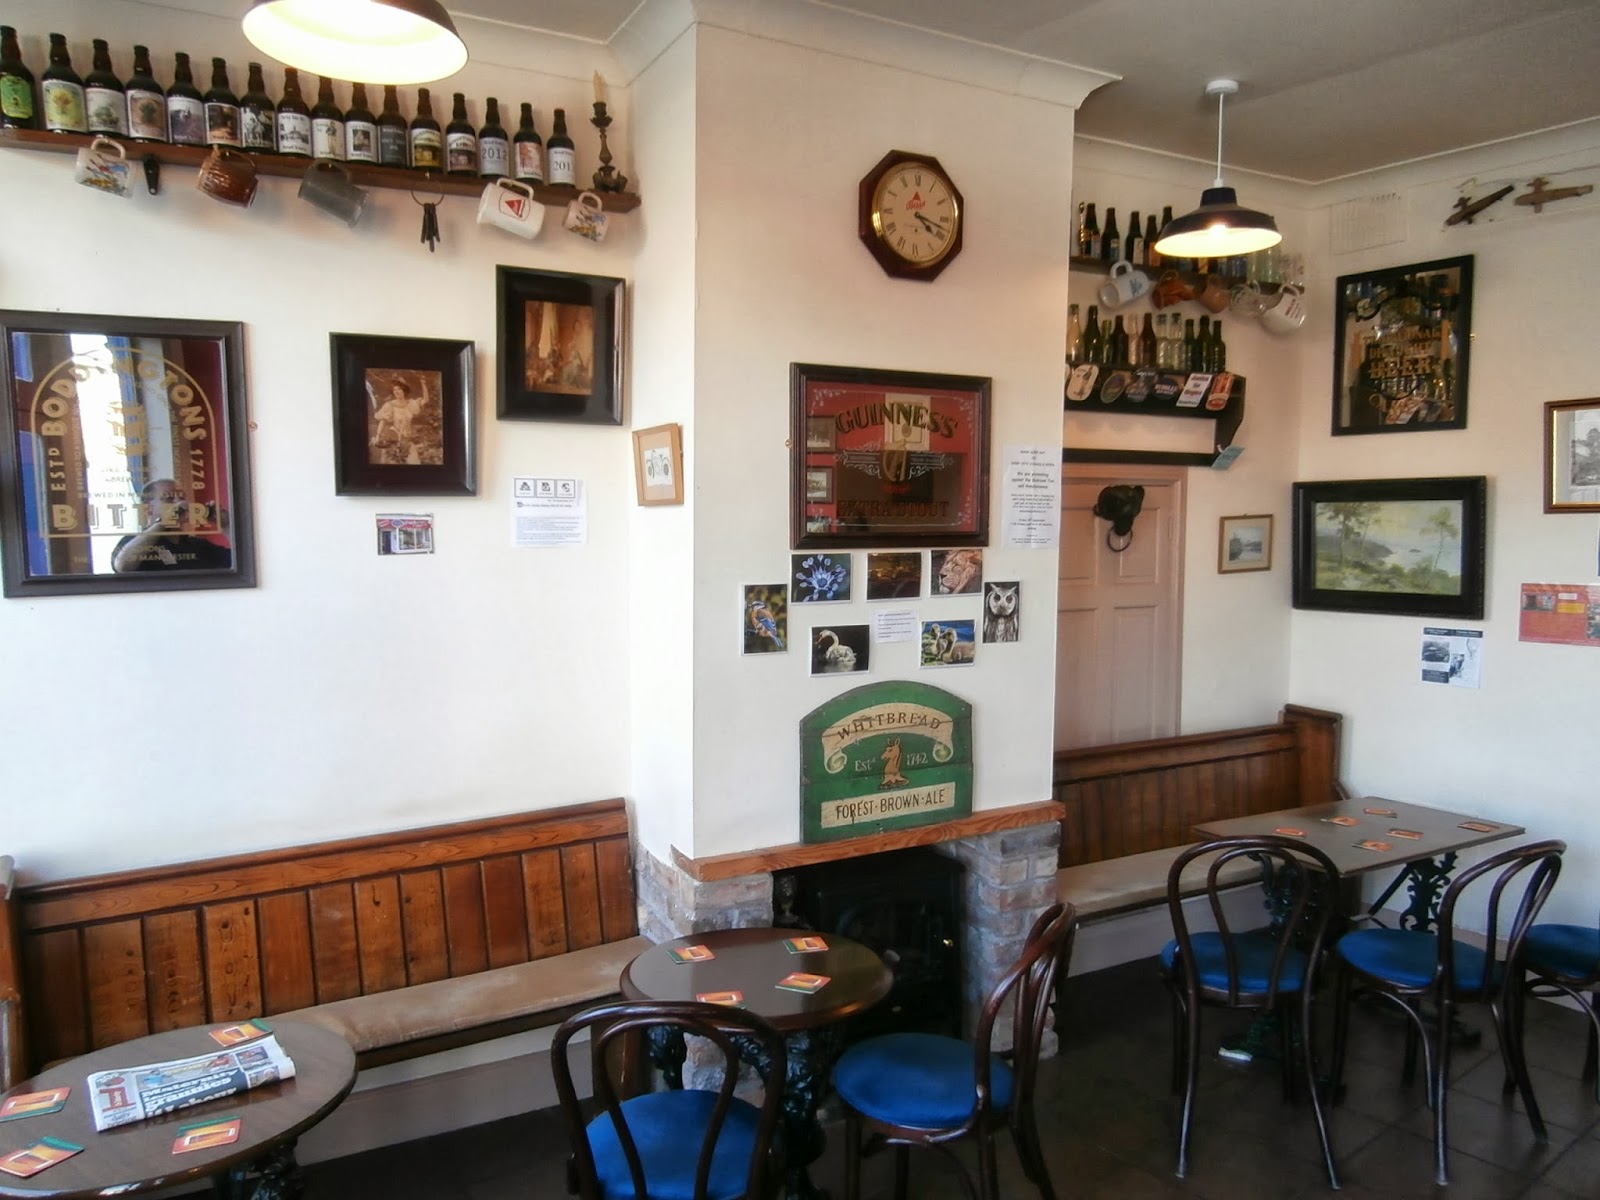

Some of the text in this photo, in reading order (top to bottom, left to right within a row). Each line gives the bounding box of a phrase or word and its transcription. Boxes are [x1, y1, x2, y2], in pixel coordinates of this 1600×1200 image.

[1369, 355, 1433, 379] BEER
[42, 360, 207, 441] BODDNGTONS
[190, 447, 207, 491] 1778
[52, 503, 212, 530] BITTER
[837, 712, 940, 741] WHITBREAD
[906, 752, 929, 766] 1742
[836, 788, 945, 820] FOREST BROWN ALE
